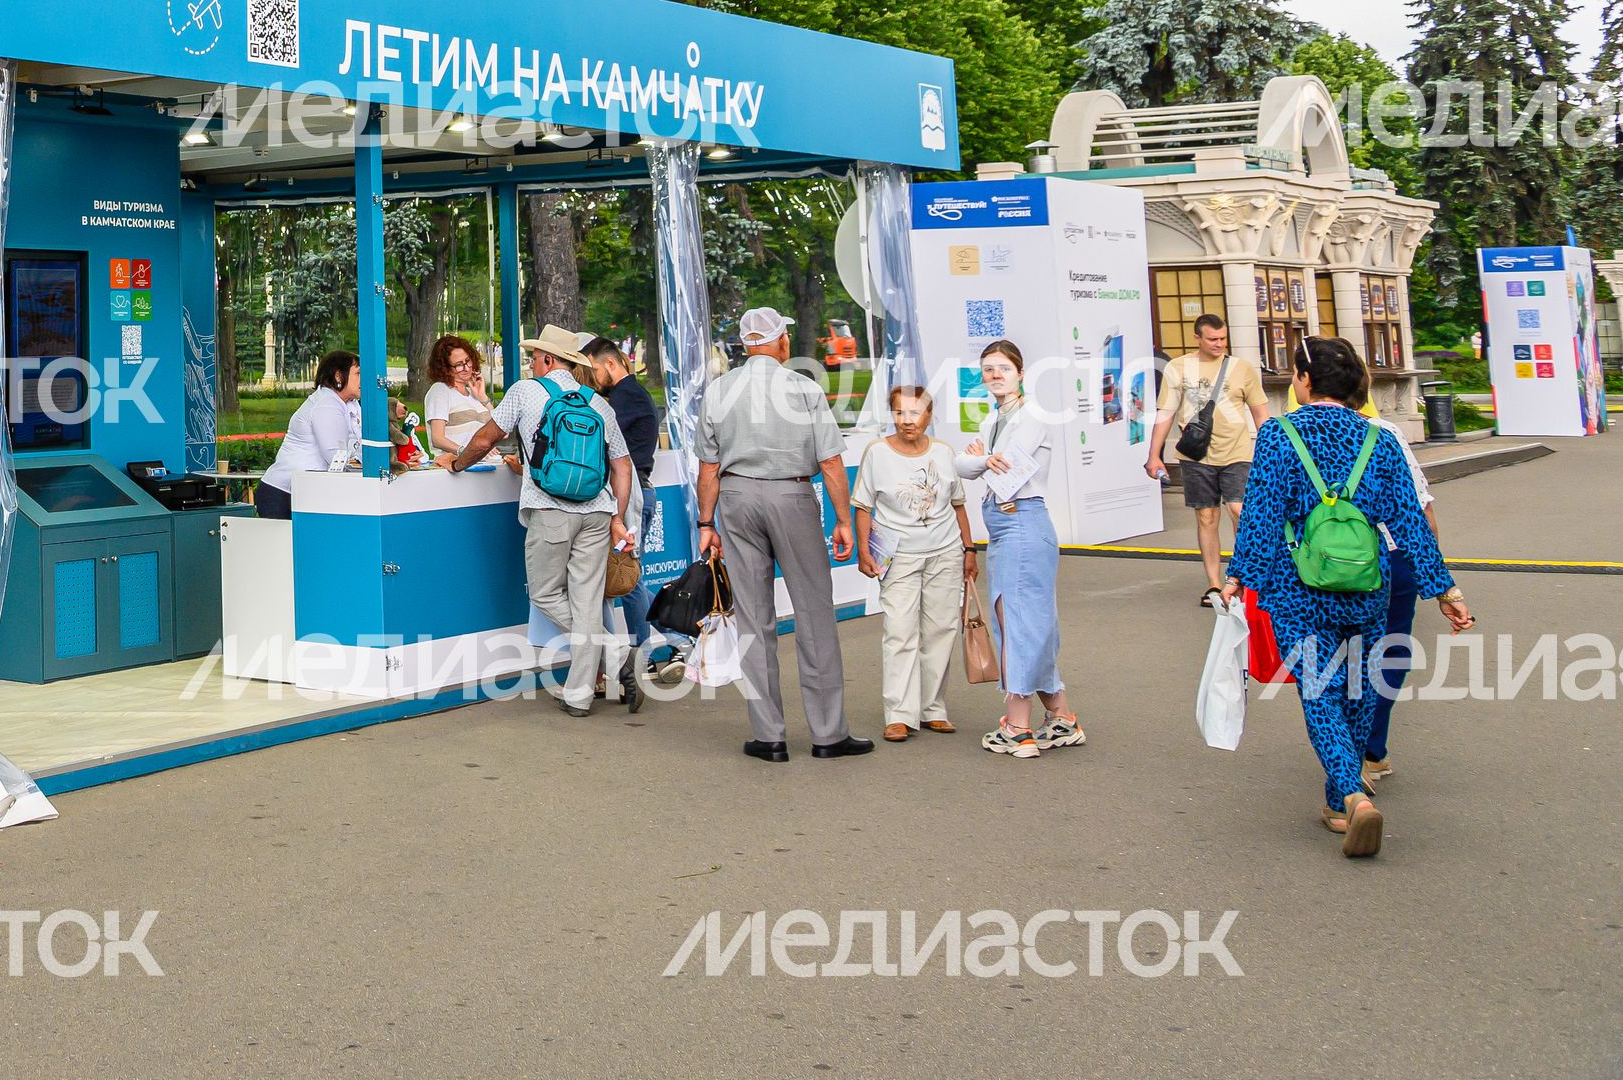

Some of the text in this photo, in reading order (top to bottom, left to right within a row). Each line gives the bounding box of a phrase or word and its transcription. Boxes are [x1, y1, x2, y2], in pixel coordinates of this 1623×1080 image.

[339, 19, 765, 128] ЛЕТИМ НА КАМЧАТКУ
[94, 200, 163, 213] ВИДЫ ТУРИЗМА
[82, 216, 175, 229] В КАМЧАТСКОМ КРАЕ
[1069, 270, 1107, 283] Кредитование
[1070, 290, 1093, 301] туризма
[645, 559, 687, 575] ЭКСКУРСИИ
